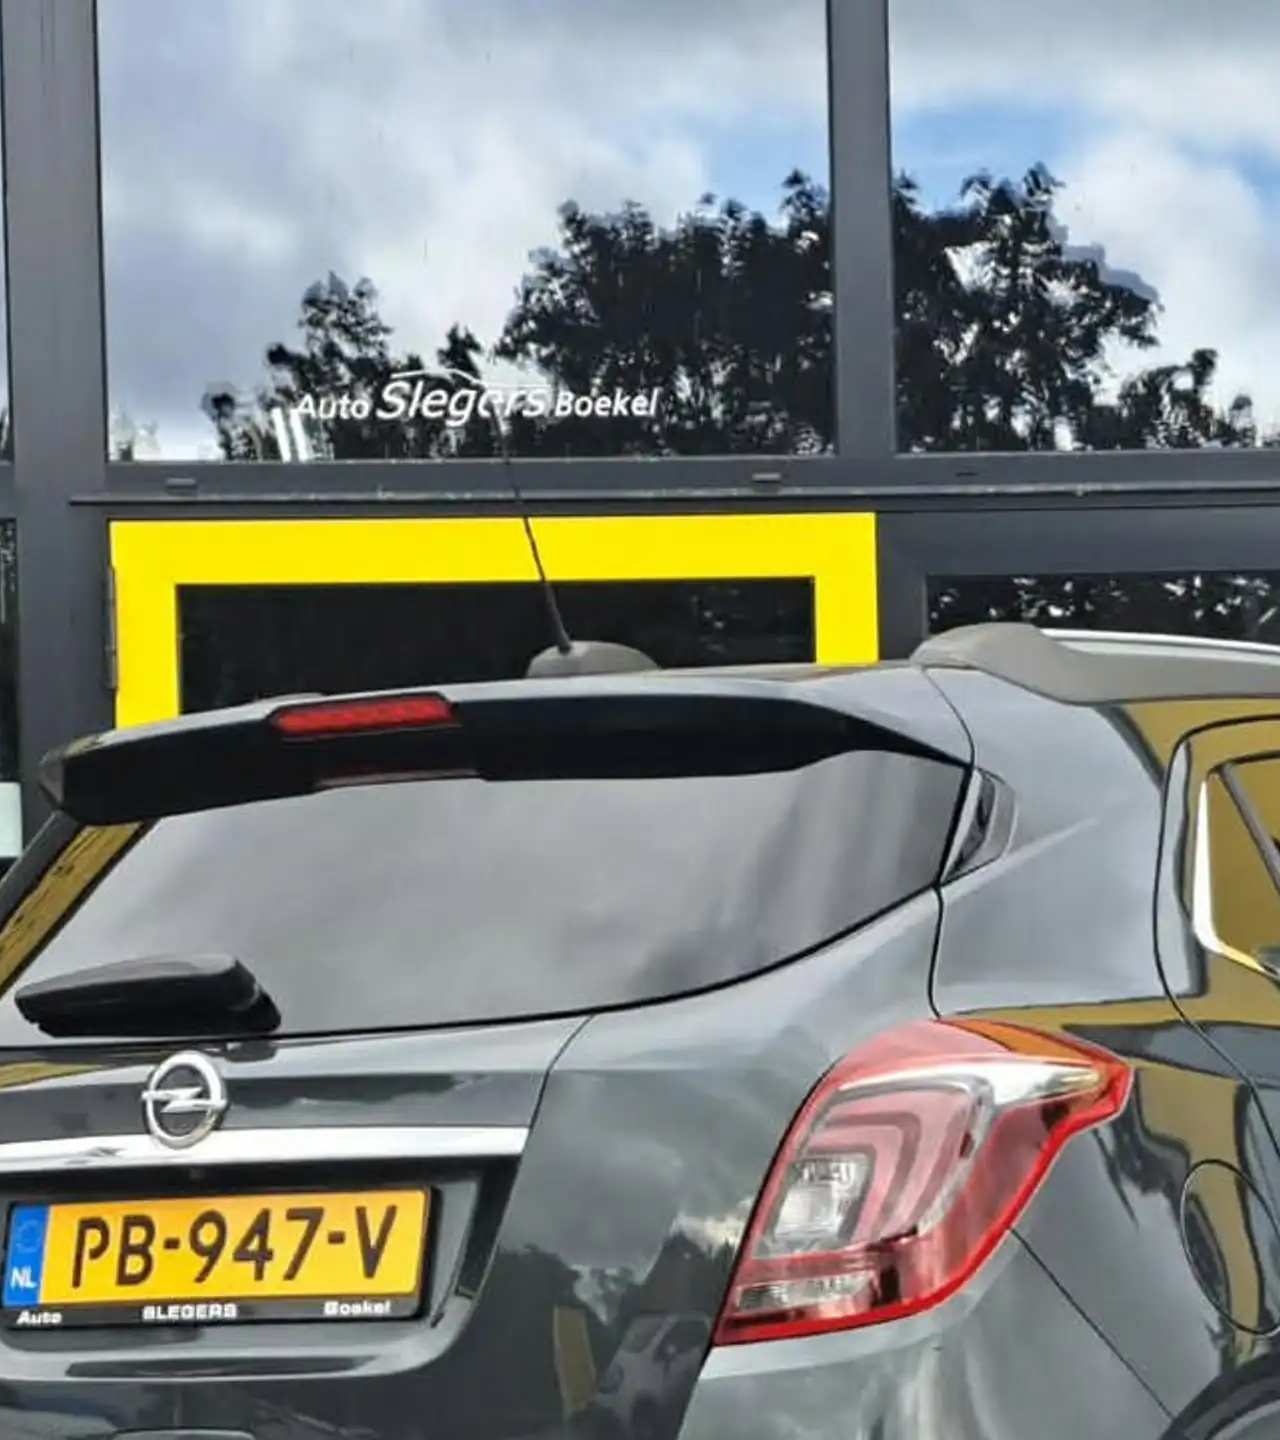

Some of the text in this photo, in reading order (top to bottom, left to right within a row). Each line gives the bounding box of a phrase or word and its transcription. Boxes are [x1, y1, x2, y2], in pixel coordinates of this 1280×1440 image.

[296, 380, 660, 428] Auto Slegers Boekel
[72, 1204, 398, 1289] PB-947-V
[10, 1265, 38, 1290] NL
[16, 1309, 62, 1326] Auto
